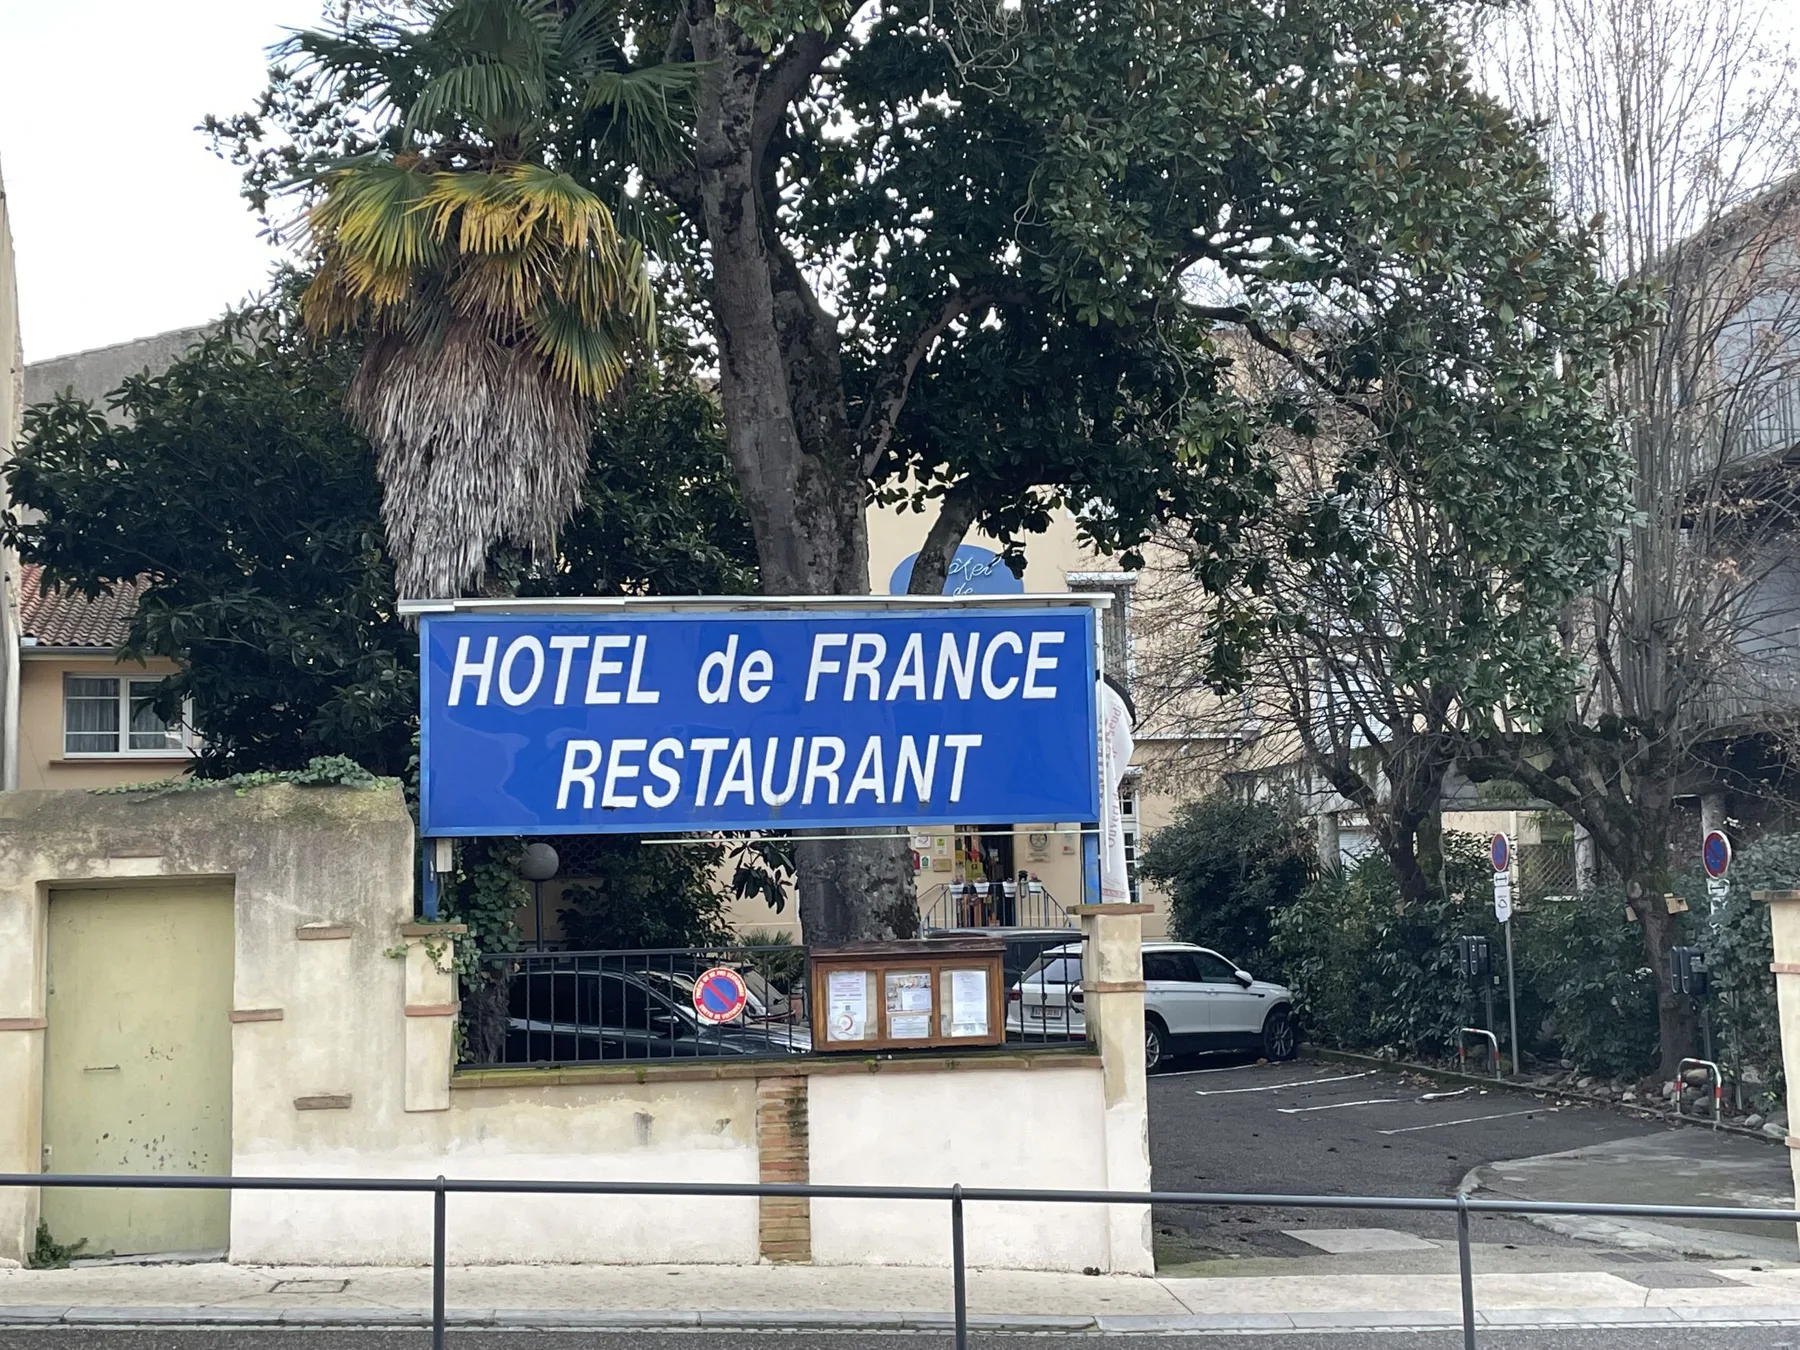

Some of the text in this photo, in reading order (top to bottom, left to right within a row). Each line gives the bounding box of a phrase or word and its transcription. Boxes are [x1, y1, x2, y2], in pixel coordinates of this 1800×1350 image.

[949, 556, 1002, 580] ôtel
[447, 631, 1065, 706] HOTEL de FRANCE
[556, 734, 983, 810] RESTAURANT
